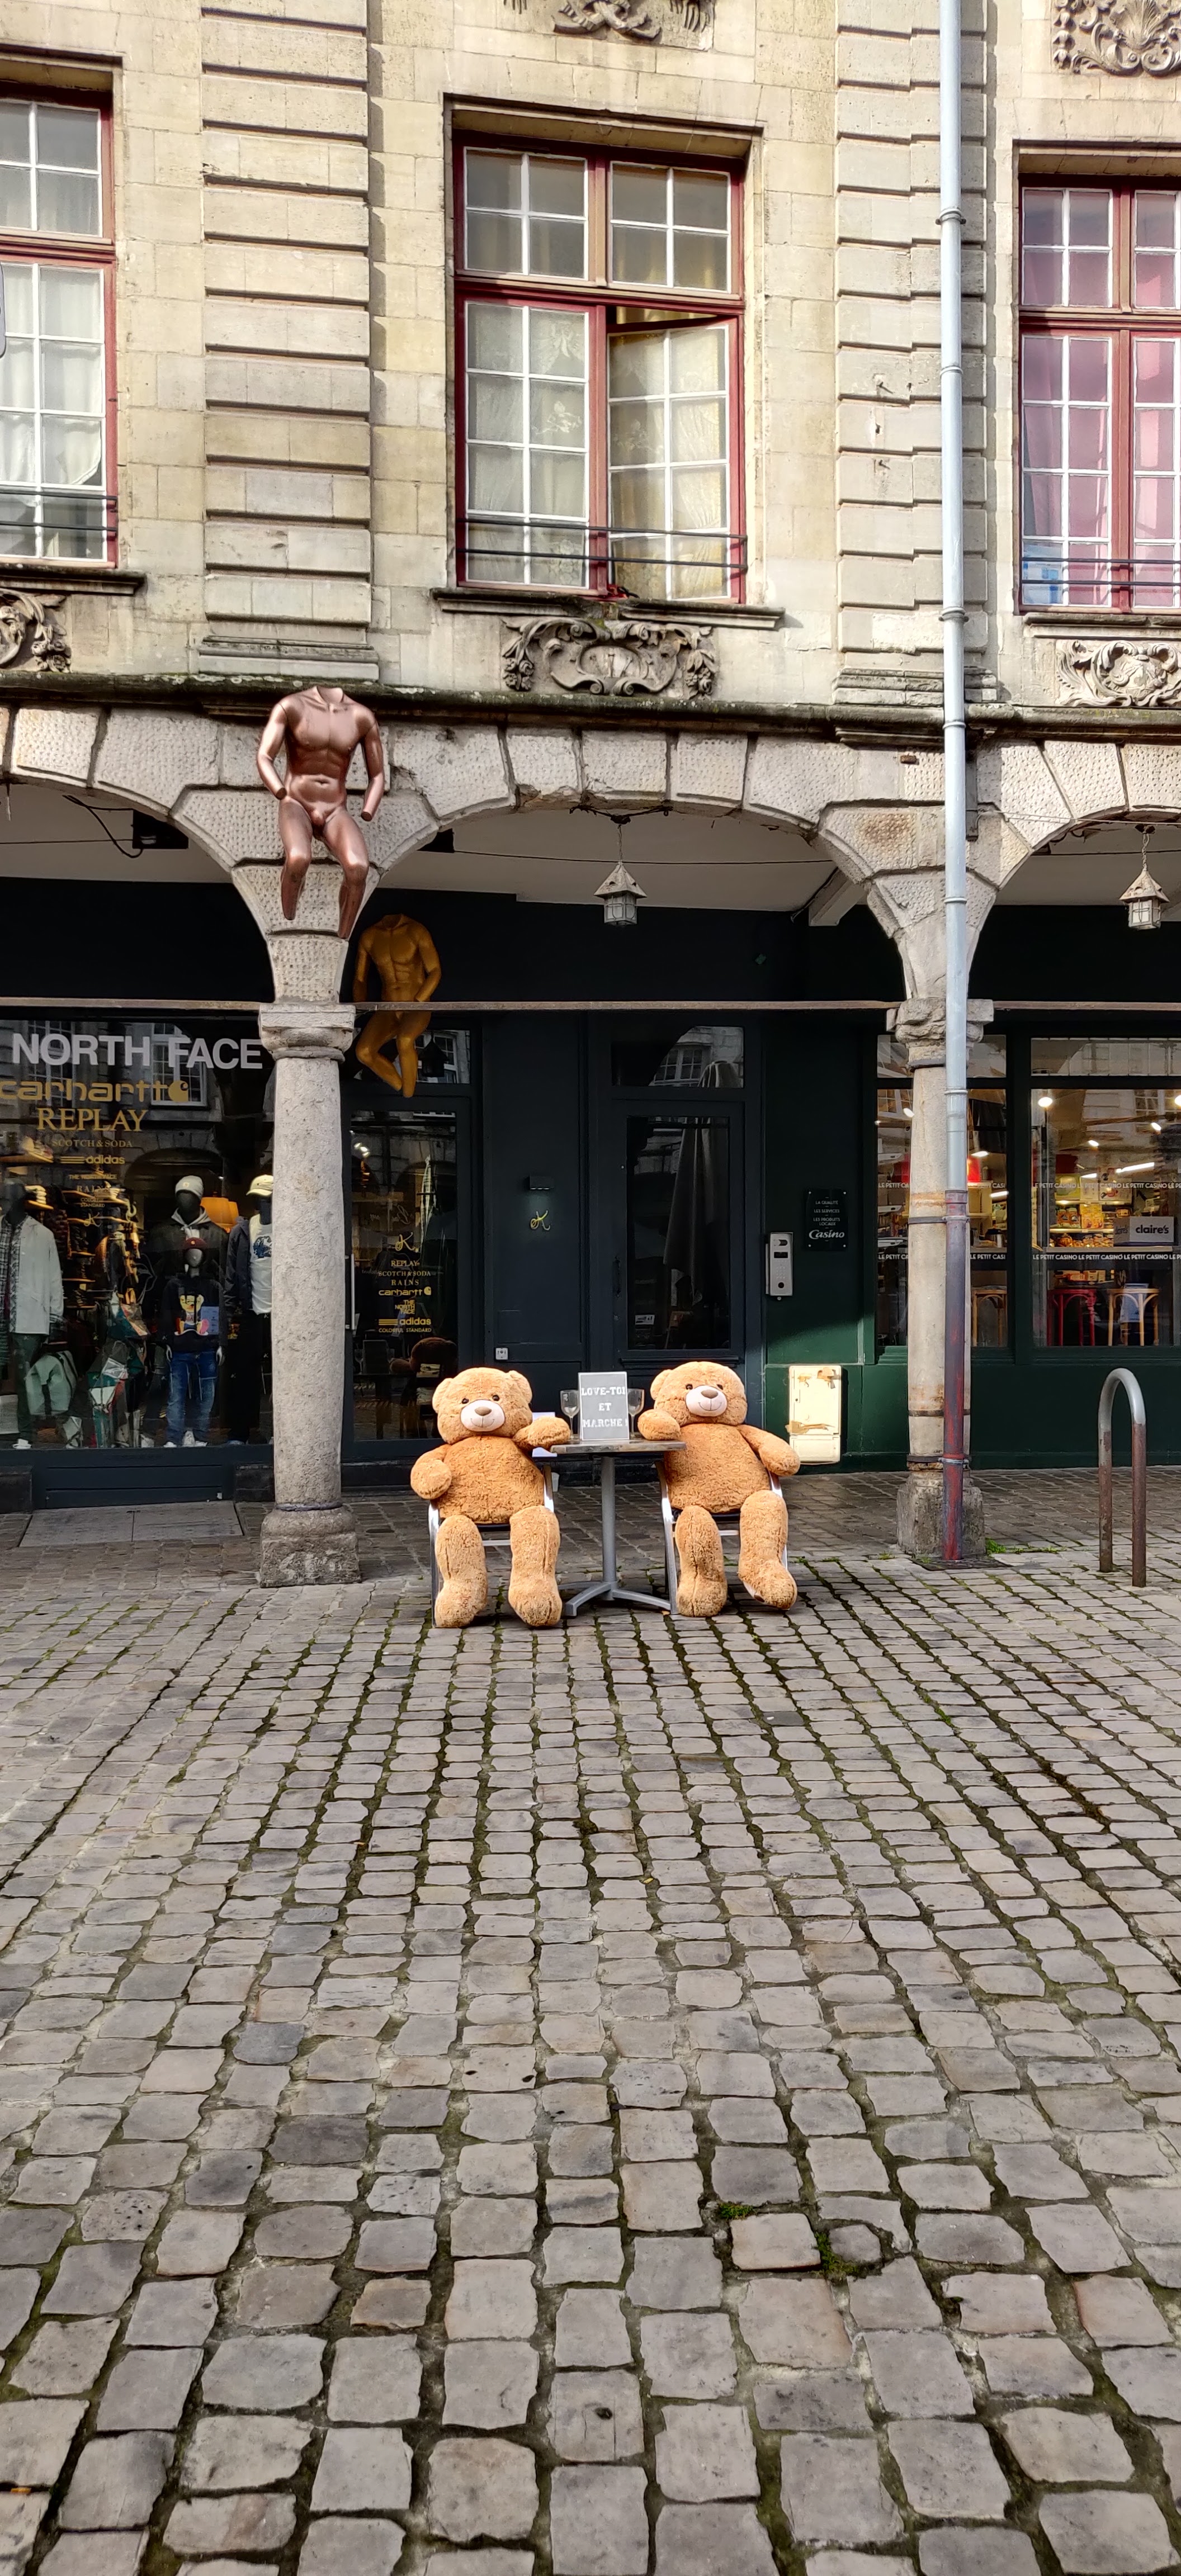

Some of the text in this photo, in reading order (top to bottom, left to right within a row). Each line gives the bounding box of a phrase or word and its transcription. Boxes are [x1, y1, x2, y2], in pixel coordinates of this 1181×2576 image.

[12, 1034, 263, 1069] NORTH FACE
[0, 1078, 168, 1102] carhartt
[37, 1107, 148, 1131] REPLAY
[86, 1154, 125, 1164] adidas
[1135, 1224, 1169, 1234] claire's
[809, 1230, 844, 1239] Casino
[399, 1317, 431, 1325] adidas
[582, 1386, 625, 1396] LOVE-TOI
[598, 1403, 612, 1411] ET
[583, 1418, 623, 1427] MARCHE
